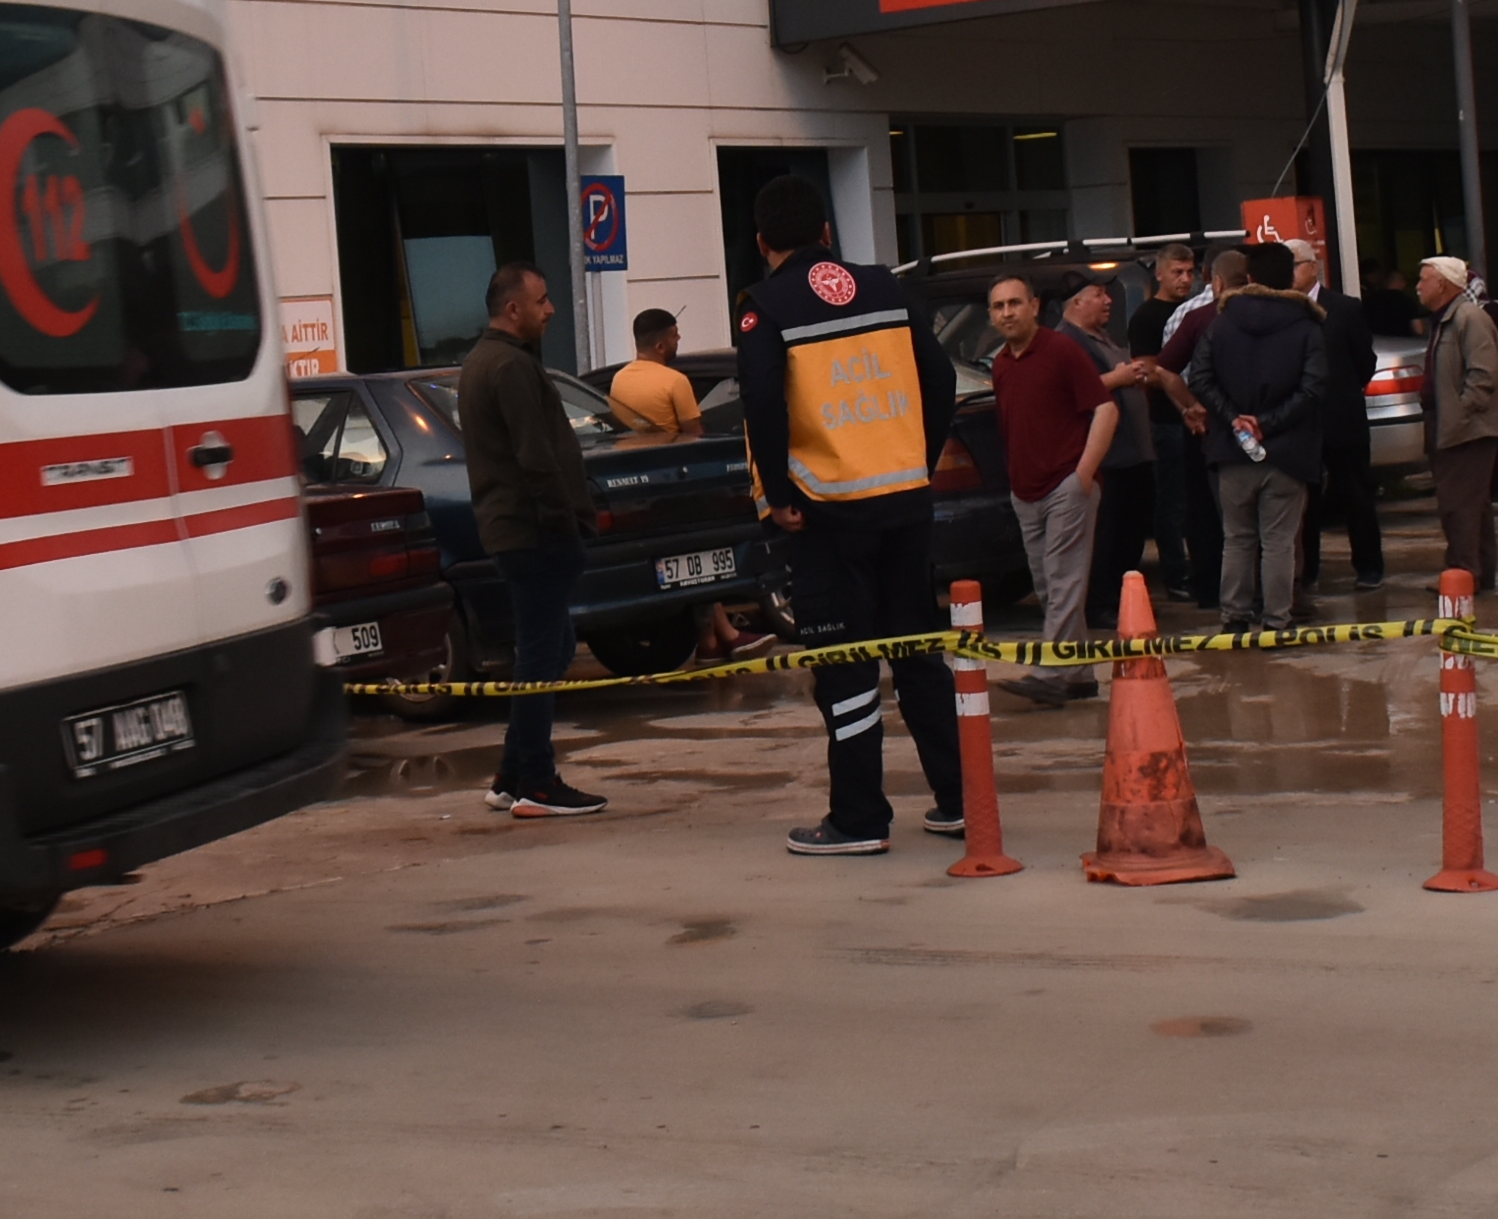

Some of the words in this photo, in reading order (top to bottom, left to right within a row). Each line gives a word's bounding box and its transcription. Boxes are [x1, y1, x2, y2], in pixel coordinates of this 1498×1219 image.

[23, 174, 93, 262] 112
[292, 318, 329, 343] AİTTİR
[831, 348, 893, 388] ACİL
[664, 558, 679, 580] 57
[711, 549, 733, 572] 995
[351, 624, 380, 651] 509
[74, 717, 103, 761] 57
